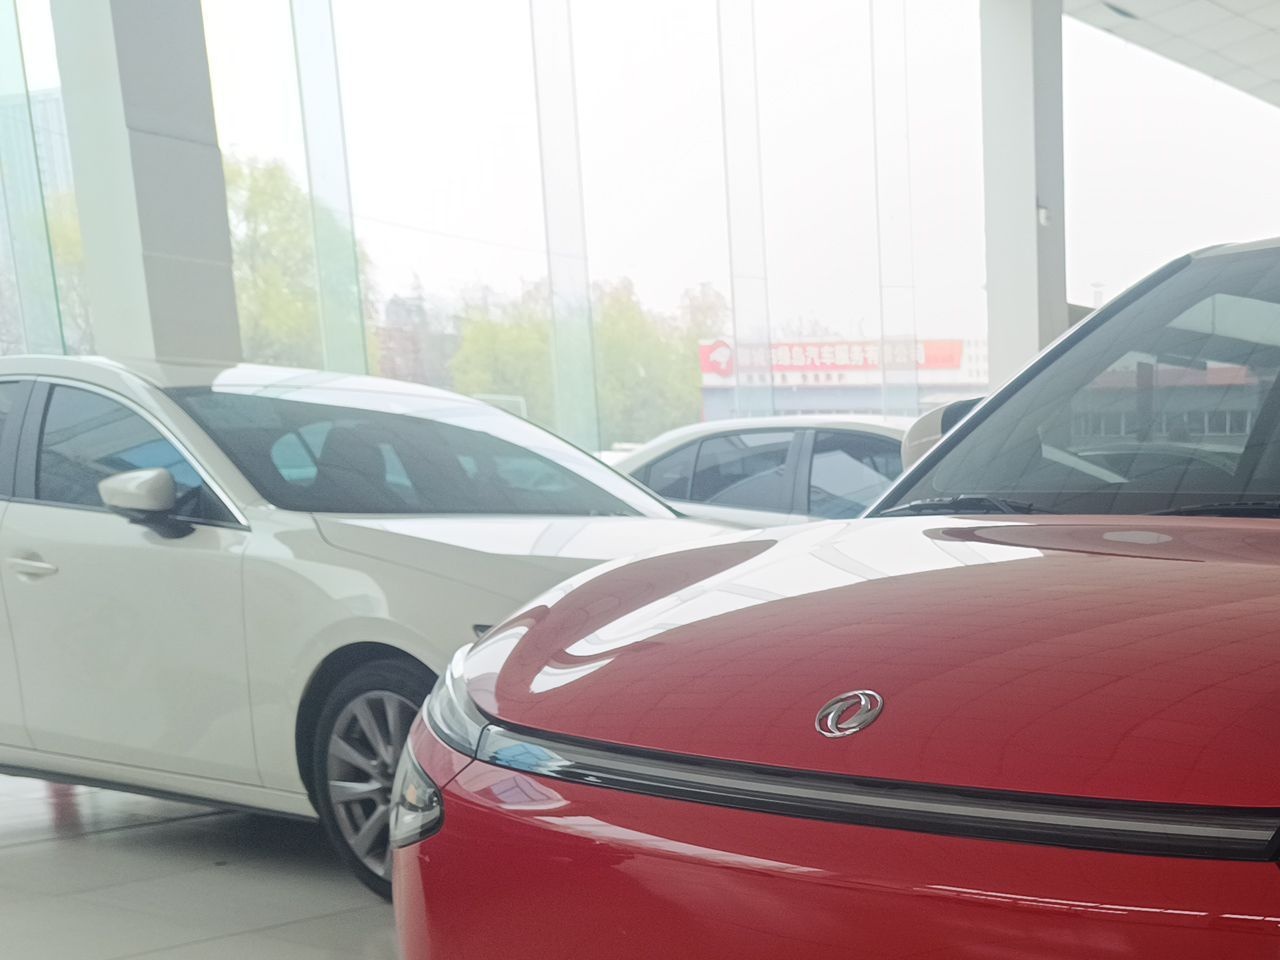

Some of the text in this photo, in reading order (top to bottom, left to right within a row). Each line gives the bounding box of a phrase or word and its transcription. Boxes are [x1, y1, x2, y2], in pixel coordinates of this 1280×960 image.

[738, 344, 925, 366] 汽车服务有限公司
